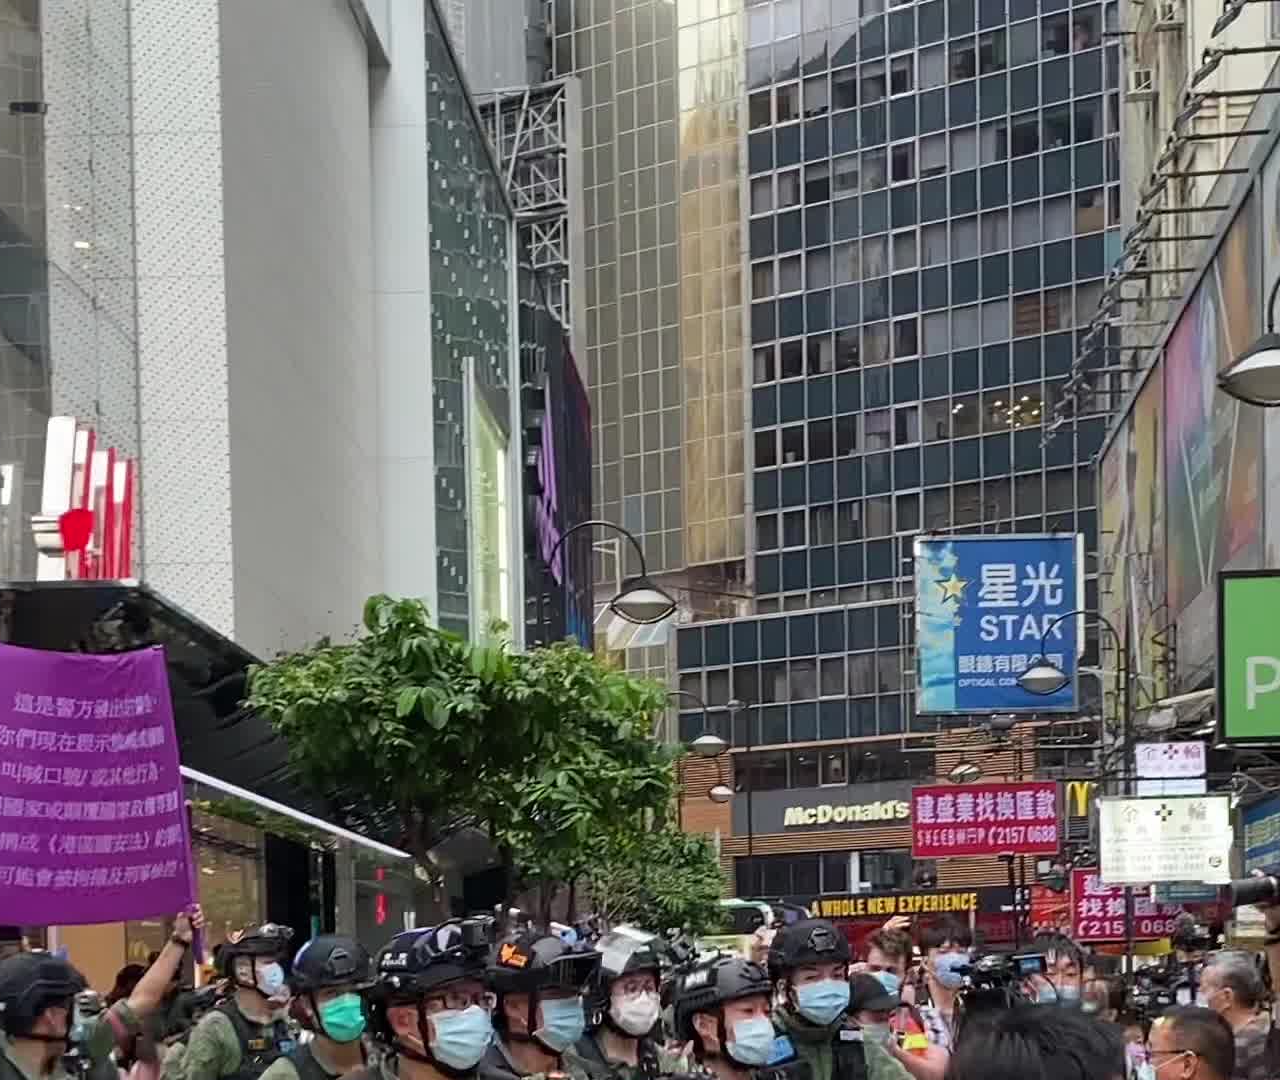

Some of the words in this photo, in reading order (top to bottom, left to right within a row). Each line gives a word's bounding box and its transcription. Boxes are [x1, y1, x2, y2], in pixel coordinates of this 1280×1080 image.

[977, 561, 1063, 608] 星光
[979, 613, 1063, 641] STAR
[784, 799, 909, 826] McDonald's
[917, 789, 1056, 824] 建盛業找換匯款
[996, 825, 1026, 844] 2157
[811, 901, 820, 917] A
[821, 898, 865, 917] WHOLE
[866, 896, 896, 914] NEW
[898, 892, 978, 912] EXPERIENCE
